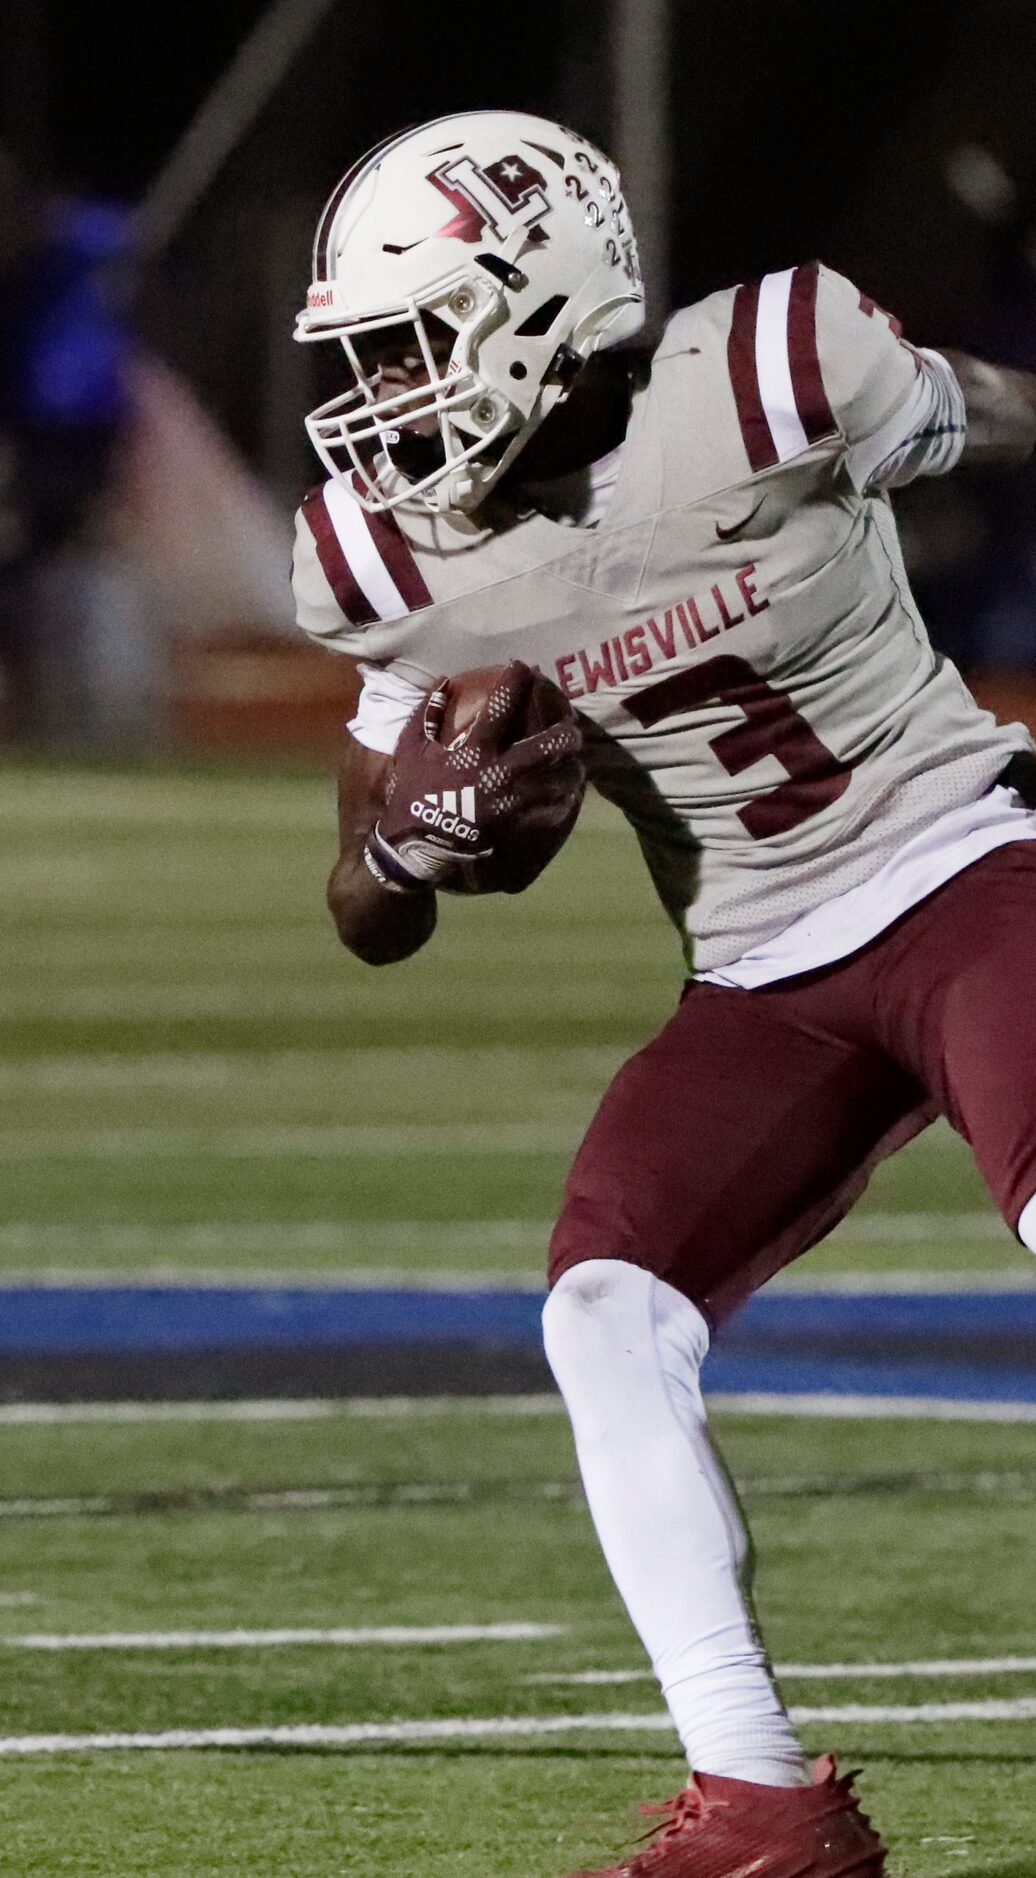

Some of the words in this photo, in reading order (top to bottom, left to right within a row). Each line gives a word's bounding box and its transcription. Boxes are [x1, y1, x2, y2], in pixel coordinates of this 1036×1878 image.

[435, 154, 554, 243] L
[565, 175, 589, 201] 2
[587, 201, 605, 228] 2
[606, 239, 622, 267] 2
[532, 562, 771, 700] EWISVILLE
[619, 653, 852, 841] 3
[409, 801, 480, 842] adidas
